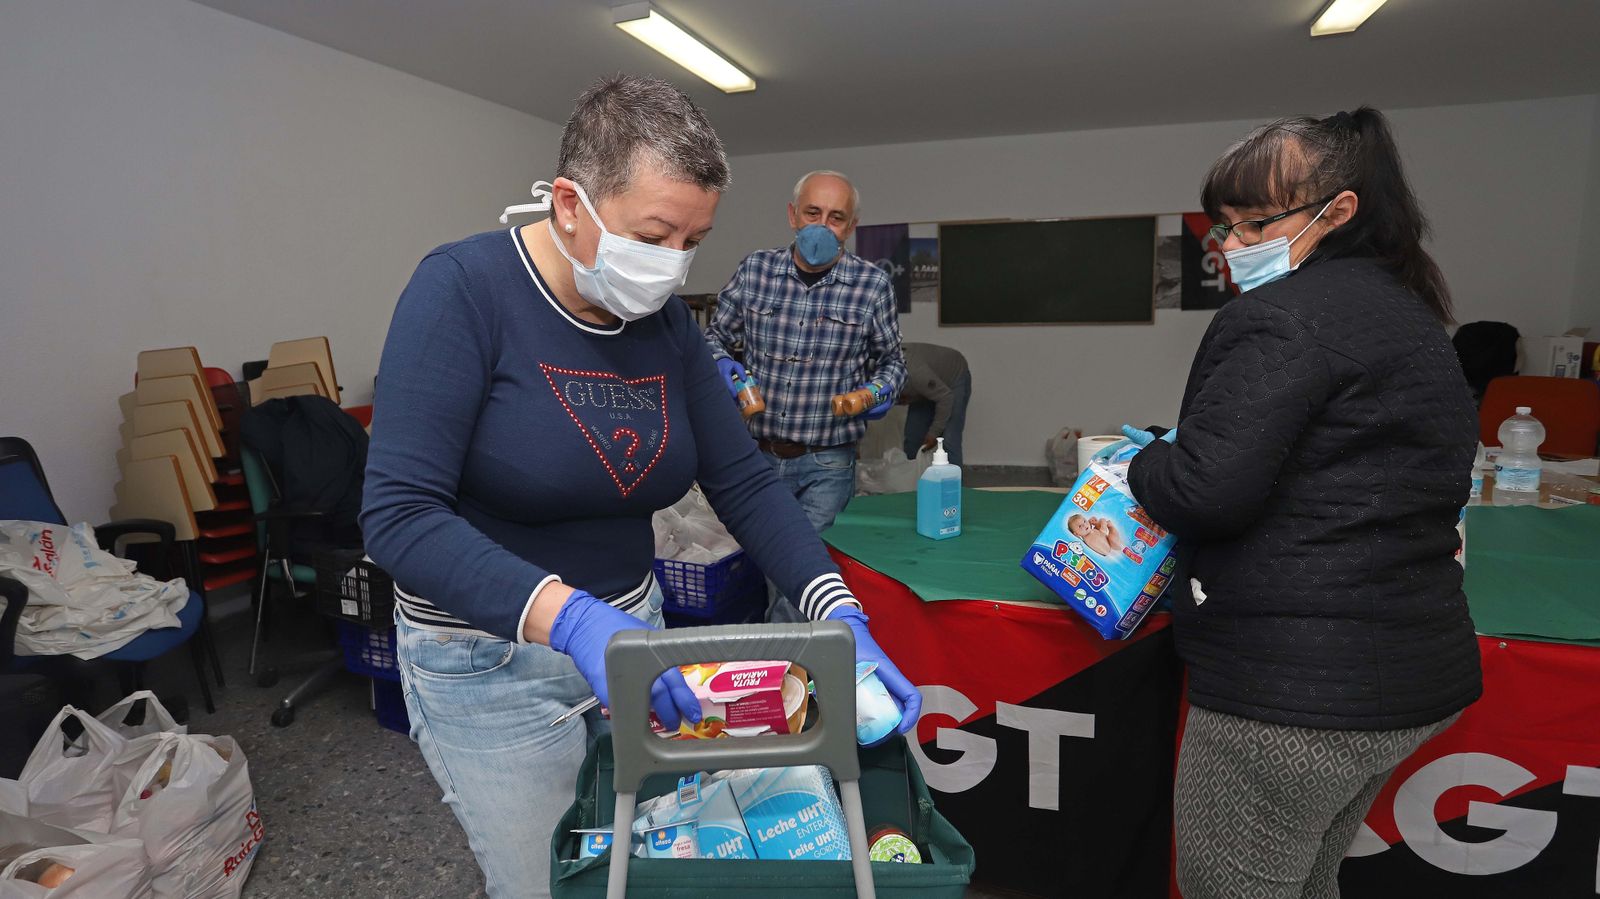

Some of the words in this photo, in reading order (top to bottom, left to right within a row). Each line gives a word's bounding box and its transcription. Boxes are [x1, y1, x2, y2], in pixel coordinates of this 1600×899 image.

[565, 381, 656, 411] GUESS
[609, 412, 634, 421] U.S.A.
[590, 424, 613, 451] WASHED
[1095, 480, 1105, 492] 4
[1073, 493, 1087, 506] 30
[1043, 558, 1060, 577] PAÑAL
[1055, 541, 1105, 586] PASITOS
[730, 669, 768, 681] VARIADA
[733, 678, 761, 688] FRUTA
[757, 817, 797, 843] Leche
[797, 800, 827, 823] UHT
[796, 817, 831, 839] ENTERA
[716, 835, 744, 858] UHT
[788, 841, 815, 860] Leite
